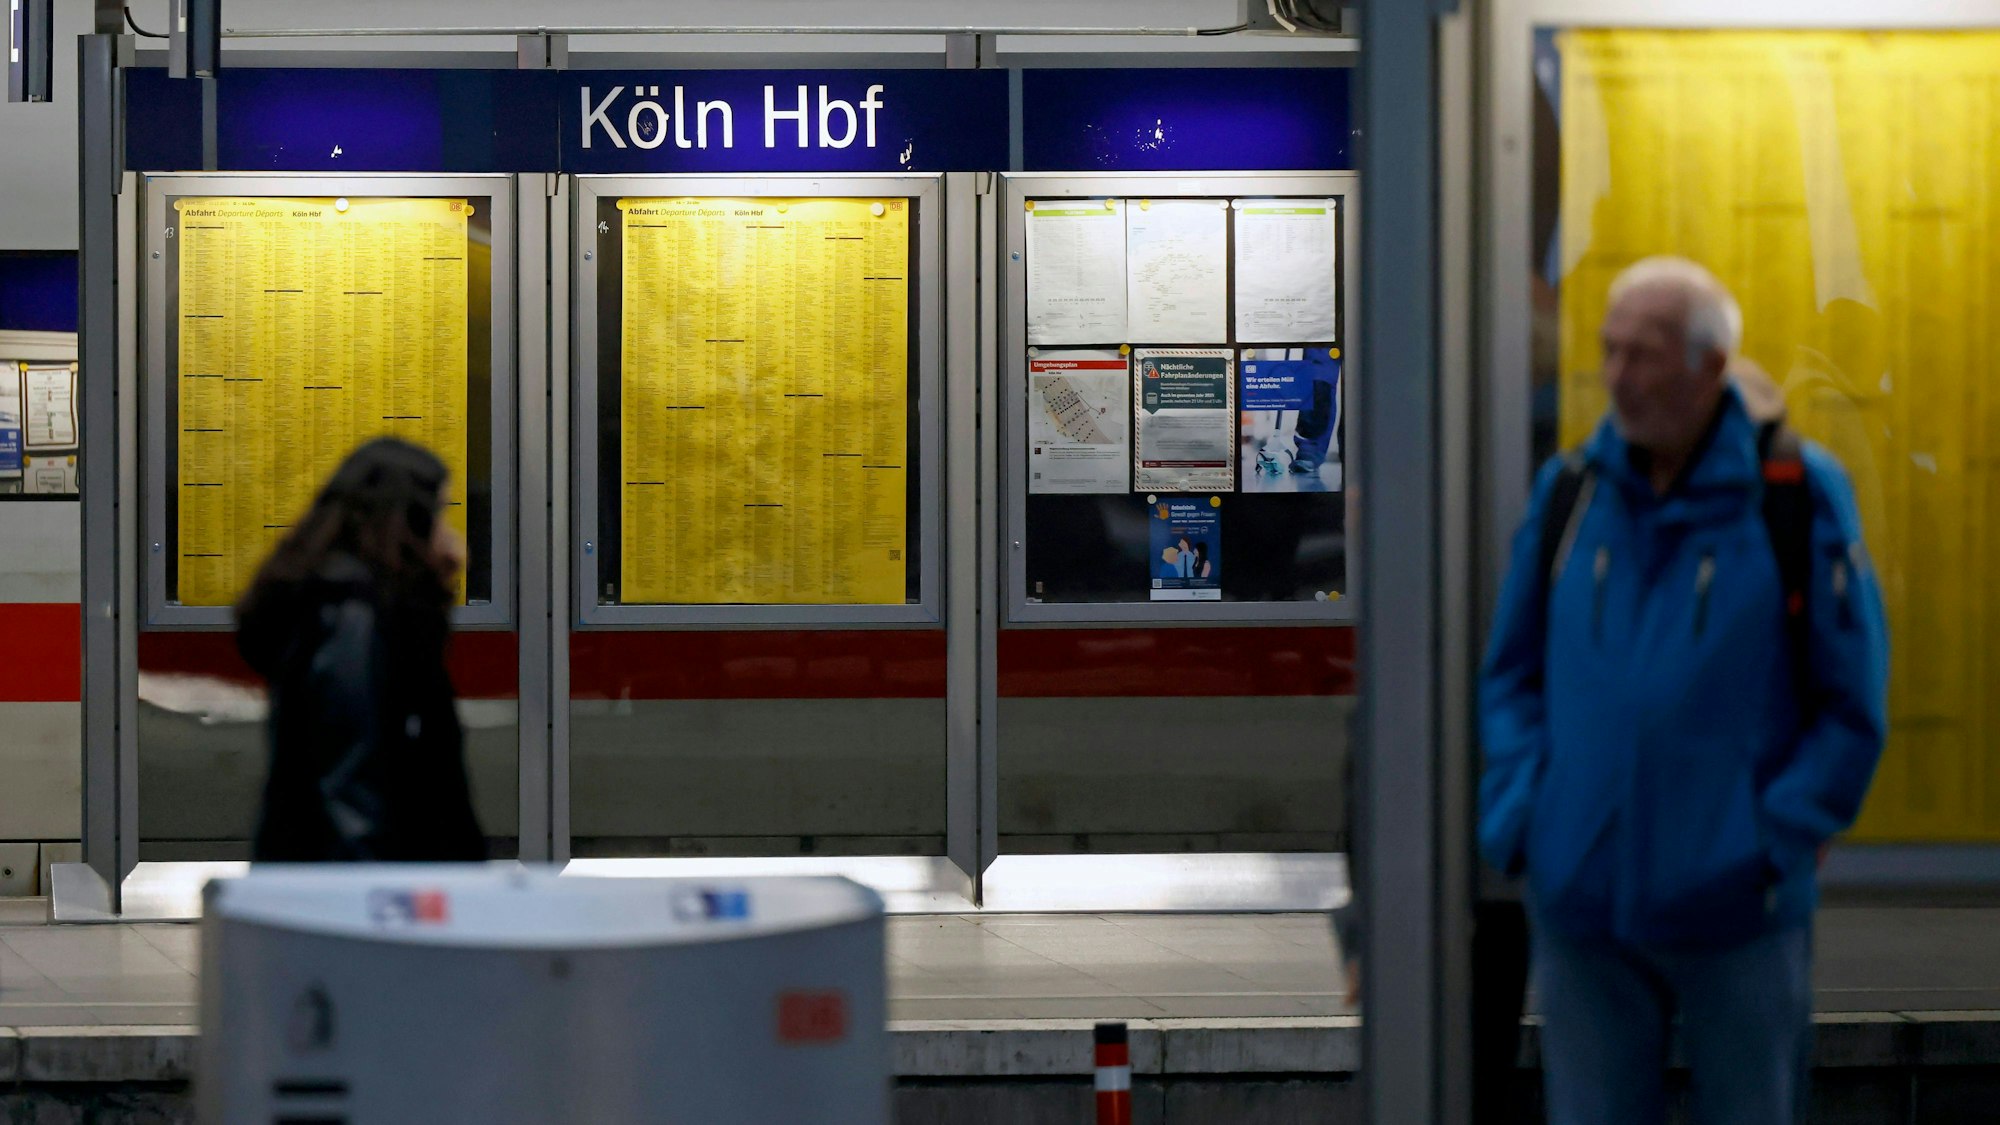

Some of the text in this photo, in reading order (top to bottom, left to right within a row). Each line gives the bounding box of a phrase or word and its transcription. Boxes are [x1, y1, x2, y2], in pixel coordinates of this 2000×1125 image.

[581, 84, 884, 149] Köln Hbf
[185, 209, 216, 217] Abfahrt
[218, 210, 254, 218] Departure
[660, 208, 696, 216] Departure
[164, 227, 174, 238] 13
